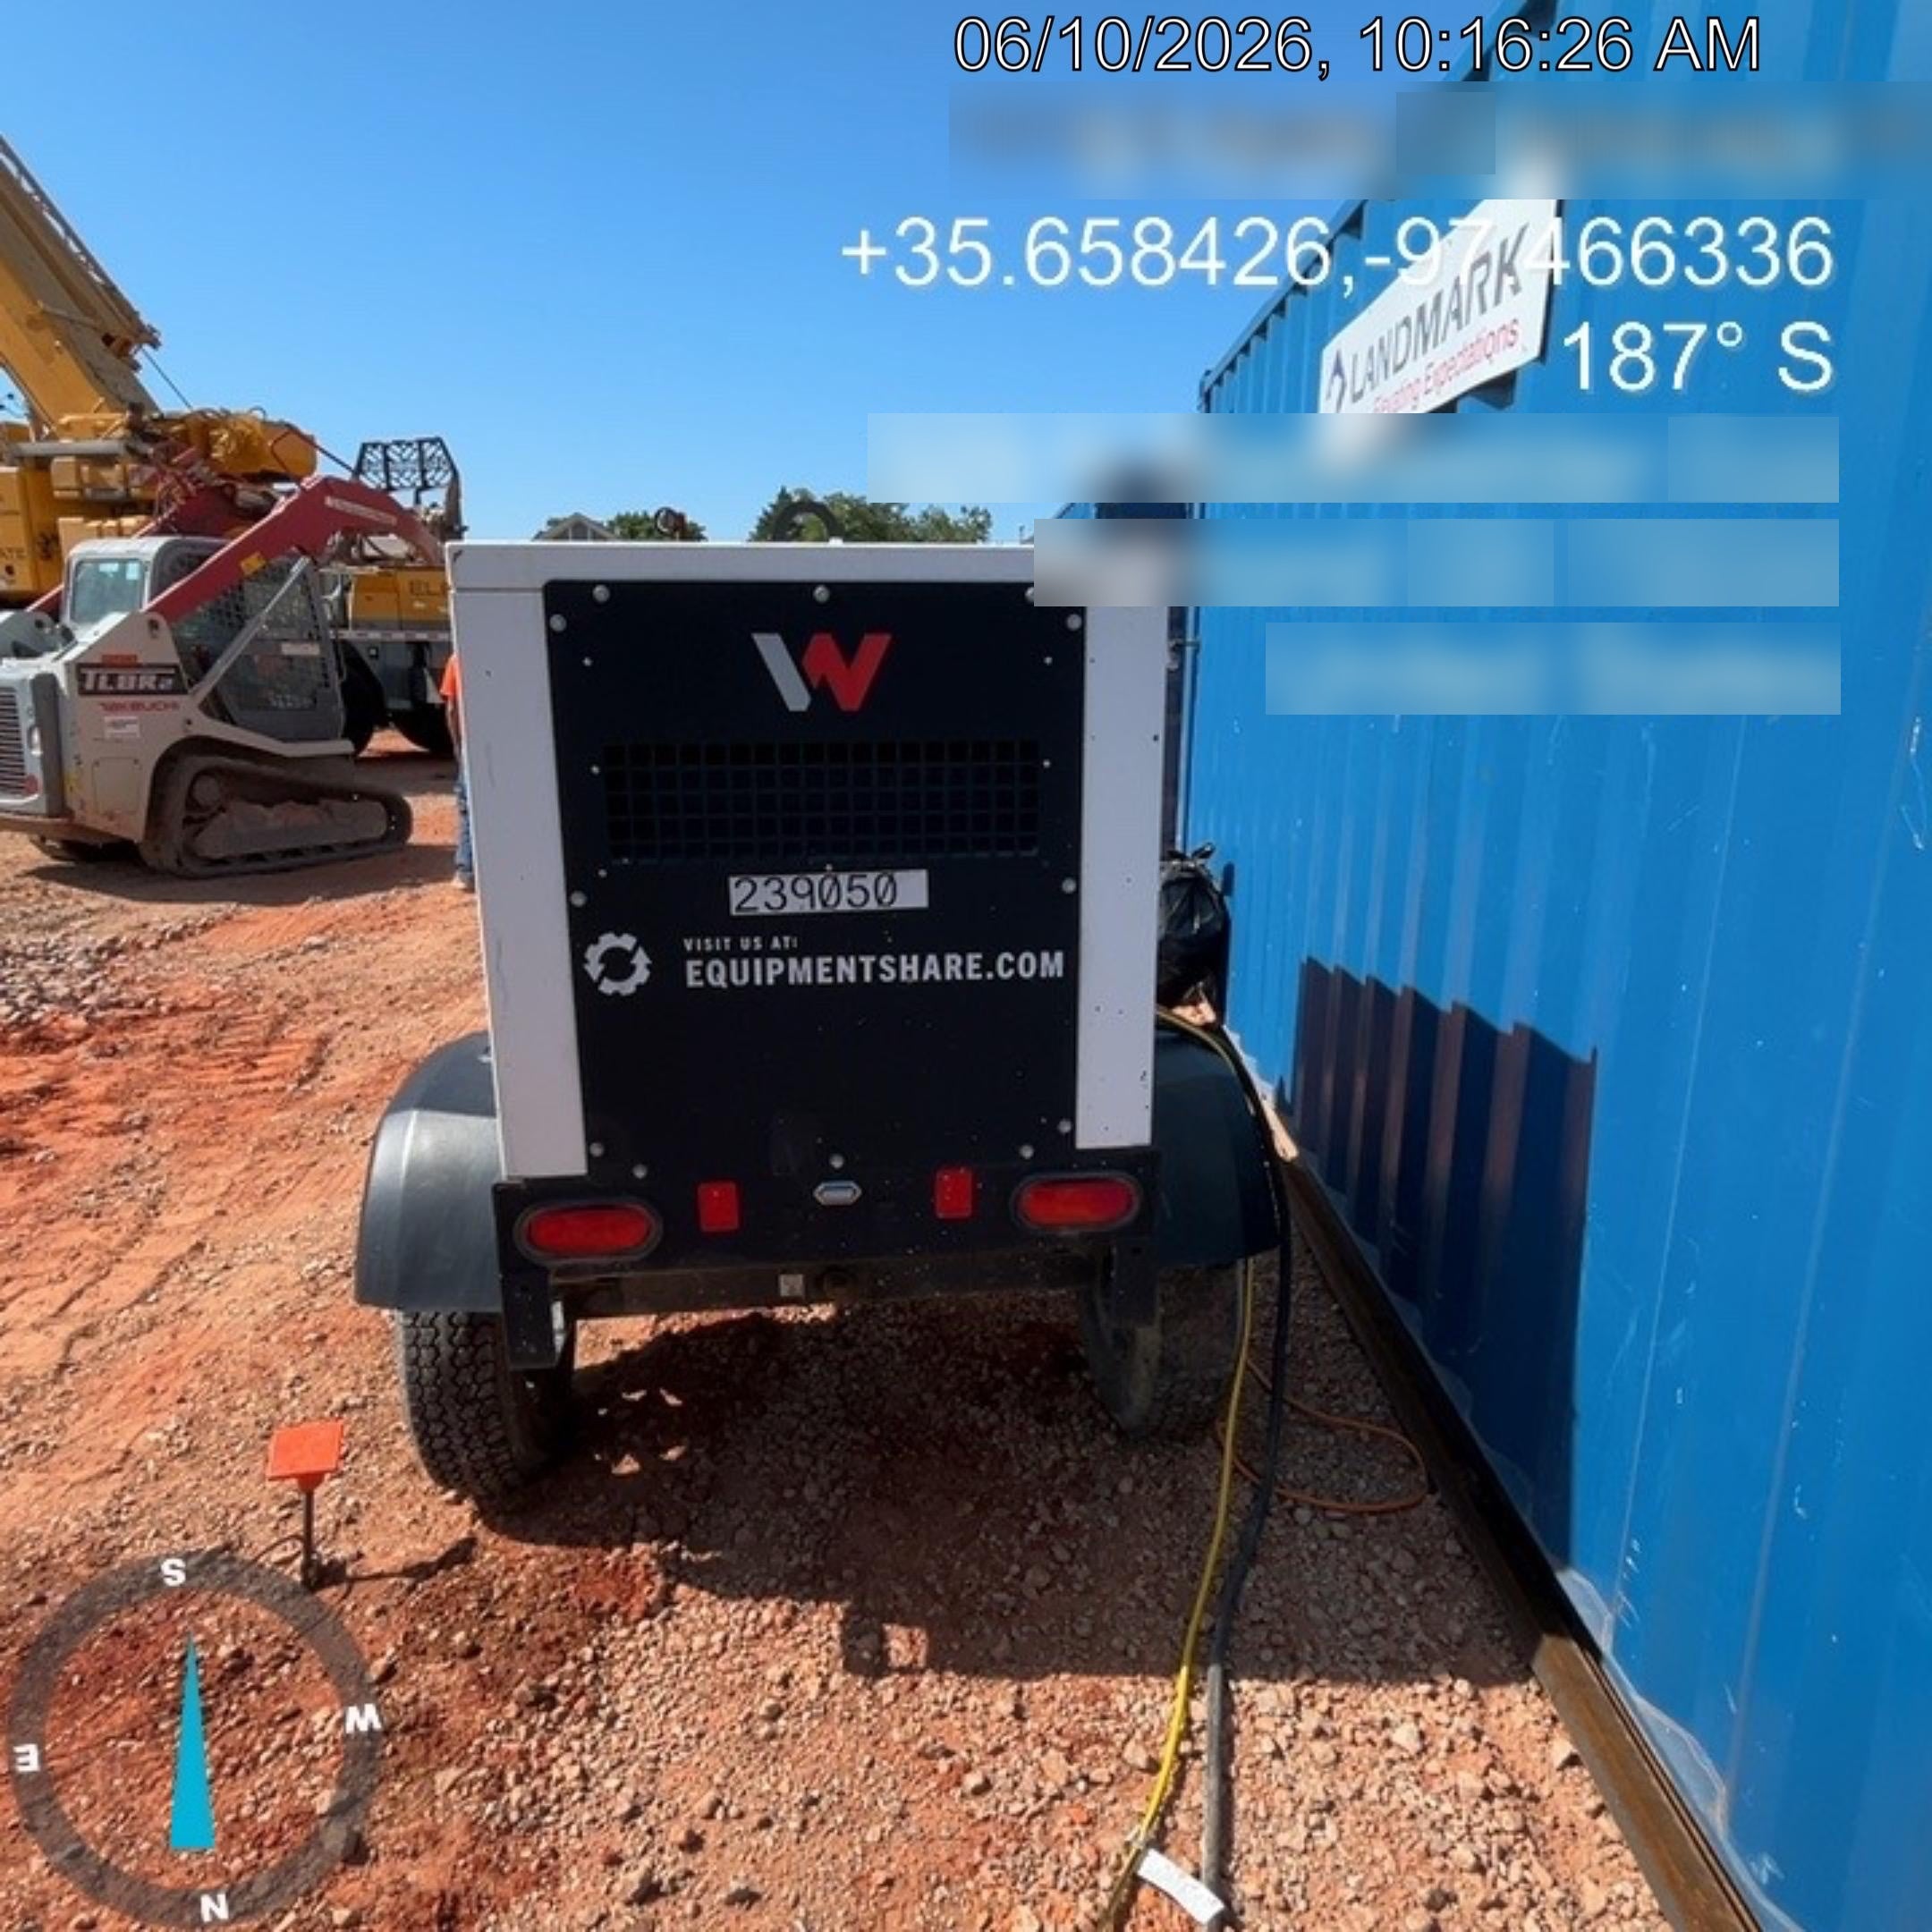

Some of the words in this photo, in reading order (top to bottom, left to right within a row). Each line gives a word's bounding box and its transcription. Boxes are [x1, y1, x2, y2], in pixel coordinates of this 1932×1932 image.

[1351, 221, 1530, 404] LANDMARK
[733, 872, 898, 912] 239050
[683, 936, 732, 952] VISIT
[740, 936, 764, 951] US
[685, 951, 1065, 988] EQUIPMENTSHARE.COM
